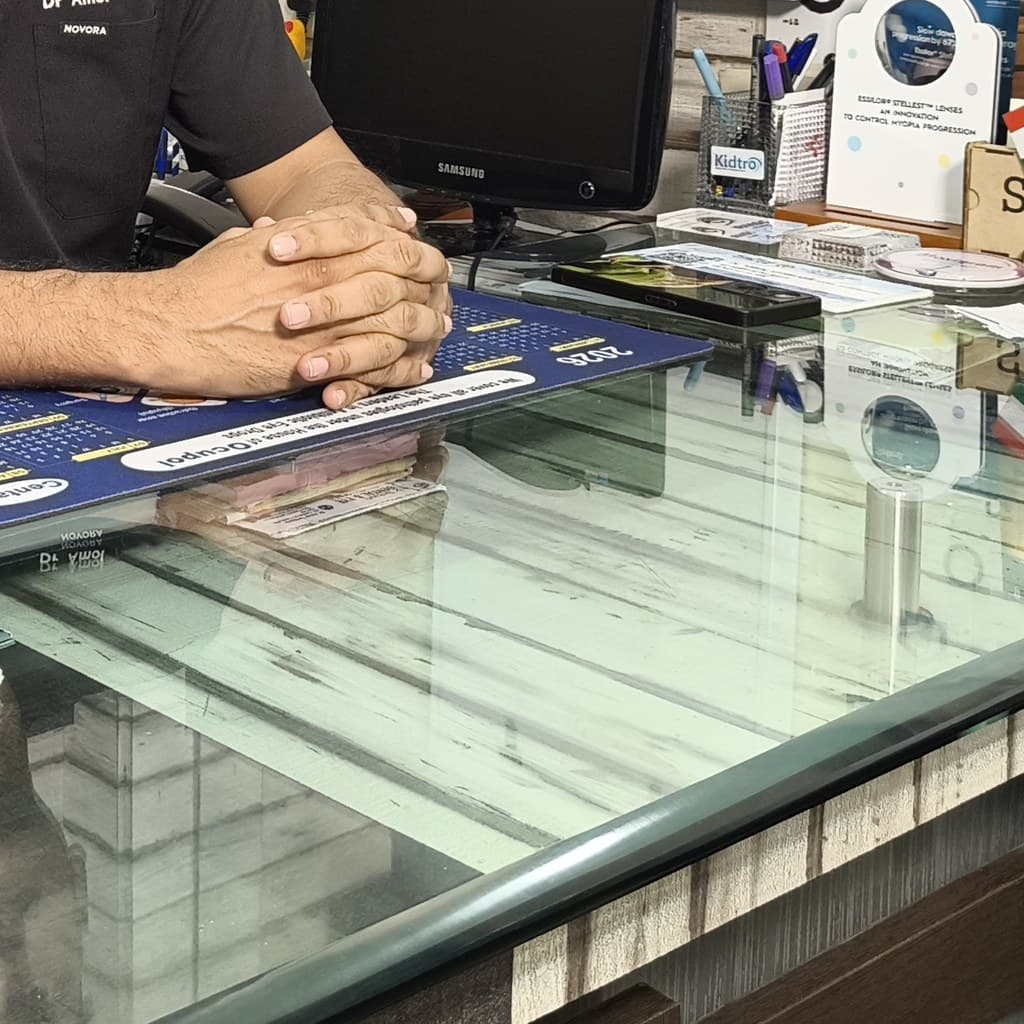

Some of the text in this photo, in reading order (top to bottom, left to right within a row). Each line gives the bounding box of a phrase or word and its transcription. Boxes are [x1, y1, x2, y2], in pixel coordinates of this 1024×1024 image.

[63, 24, 106, 35] NOVORA
[893, 110, 939, 121] INNOVATION
[935, 105, 963, 114] LENSES
[855, 115, 888, 125] CONTROL
[891, 120, 920, 129] MYOPIA
[922, 123, 976, 135] PROGRESSION
[714, 153, 758, 170] Kidtro
[438, 162, 485, 179] SAMSUNG
[555, 346, 634, 367] 2026
[156, 442, 252, 468] Ocupol
